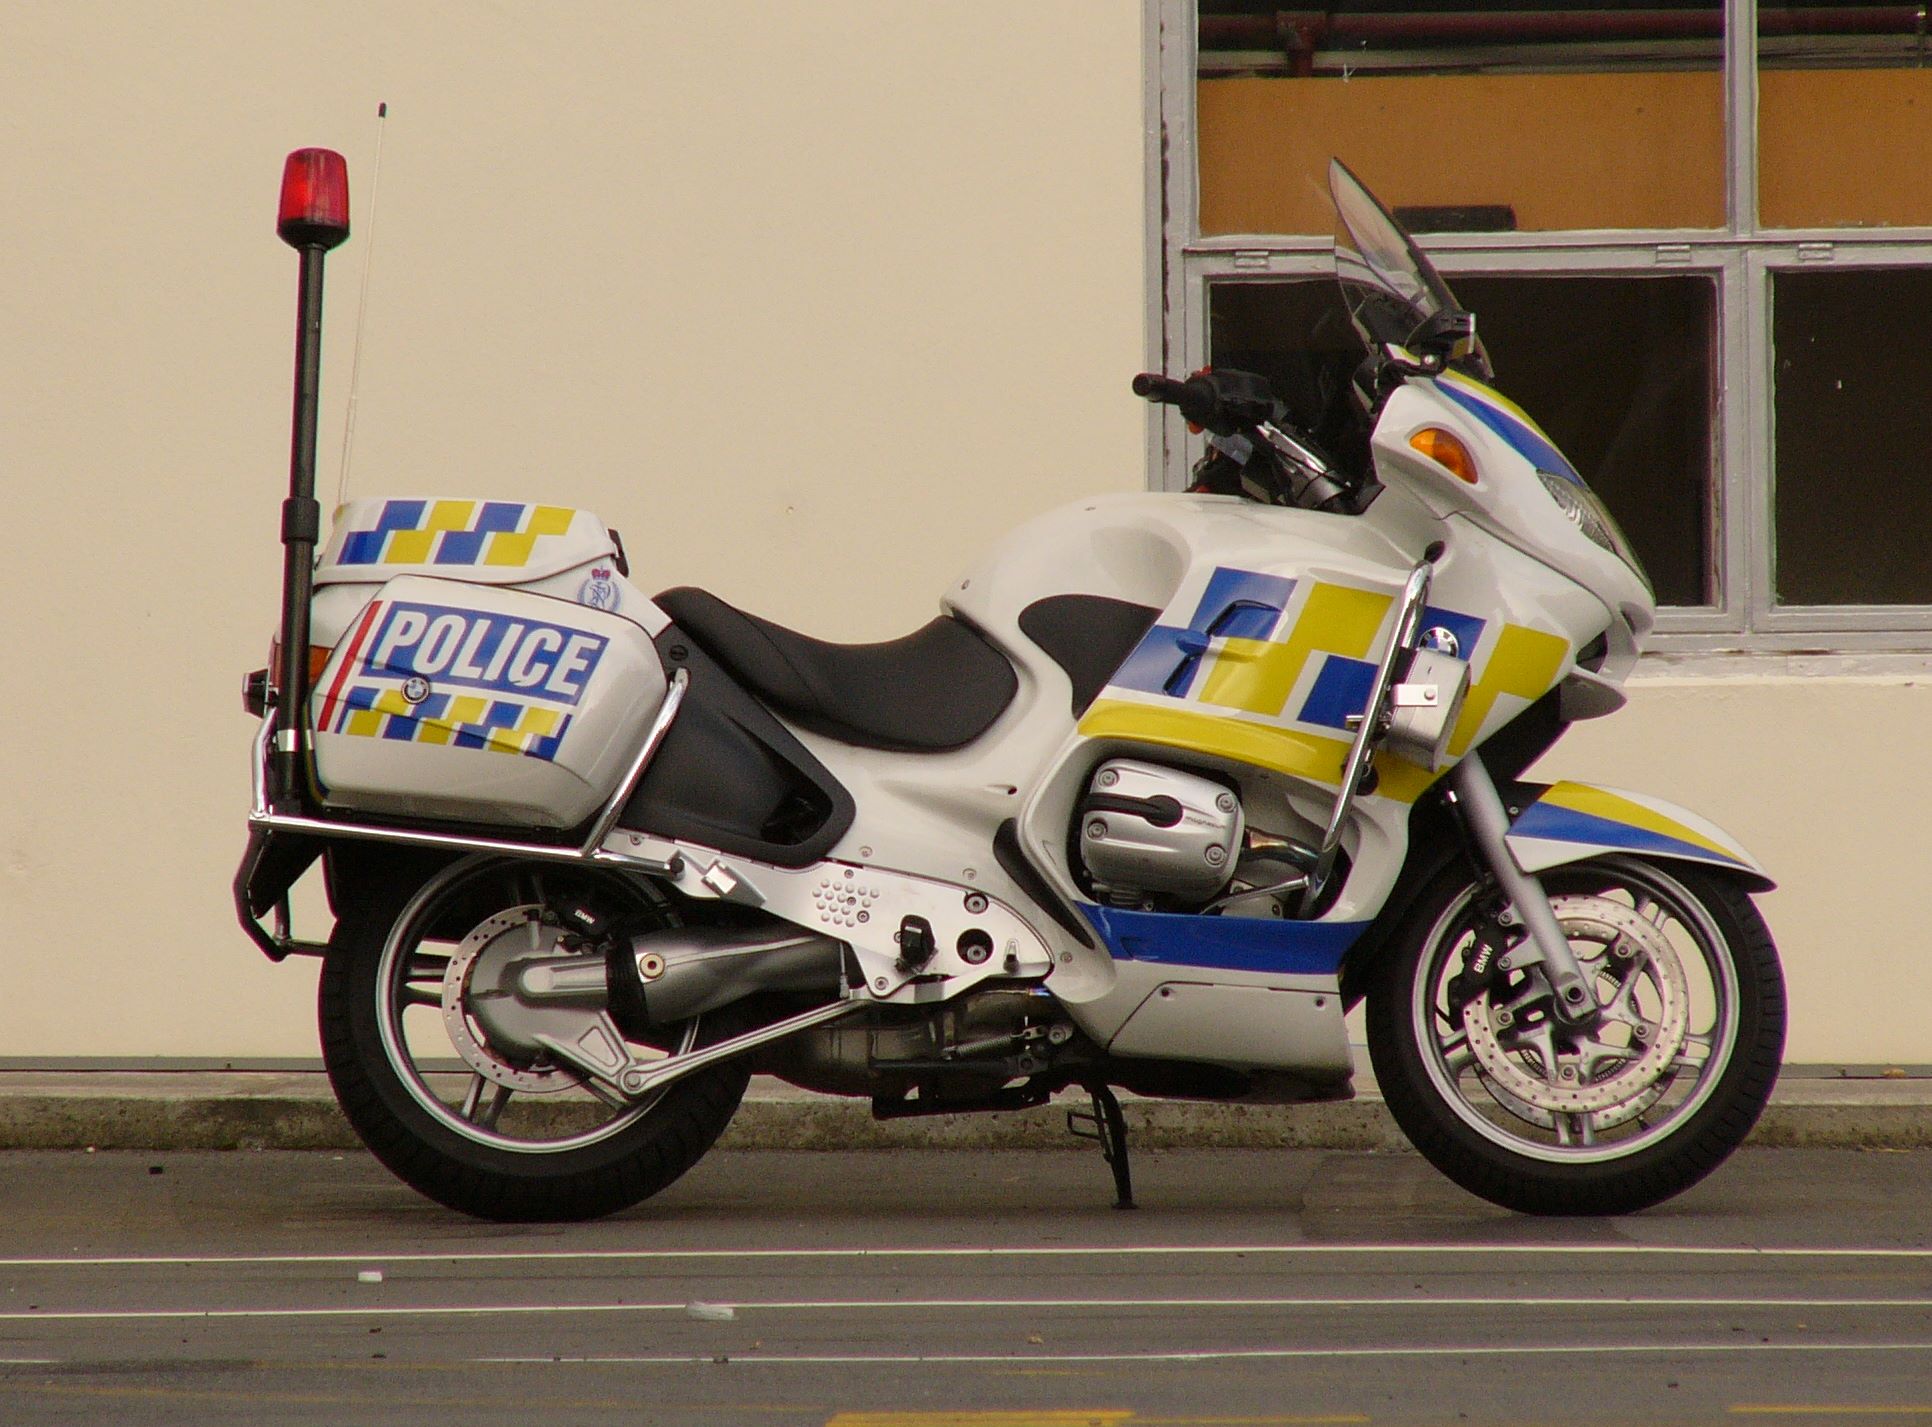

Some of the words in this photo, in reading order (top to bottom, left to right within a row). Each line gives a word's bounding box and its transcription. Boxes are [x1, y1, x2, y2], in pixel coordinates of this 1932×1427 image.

[372, 611, 601, 696] POLICE
[574, 909, 595, 923] BMW
[1474, 944, 1493, 973] BMW
